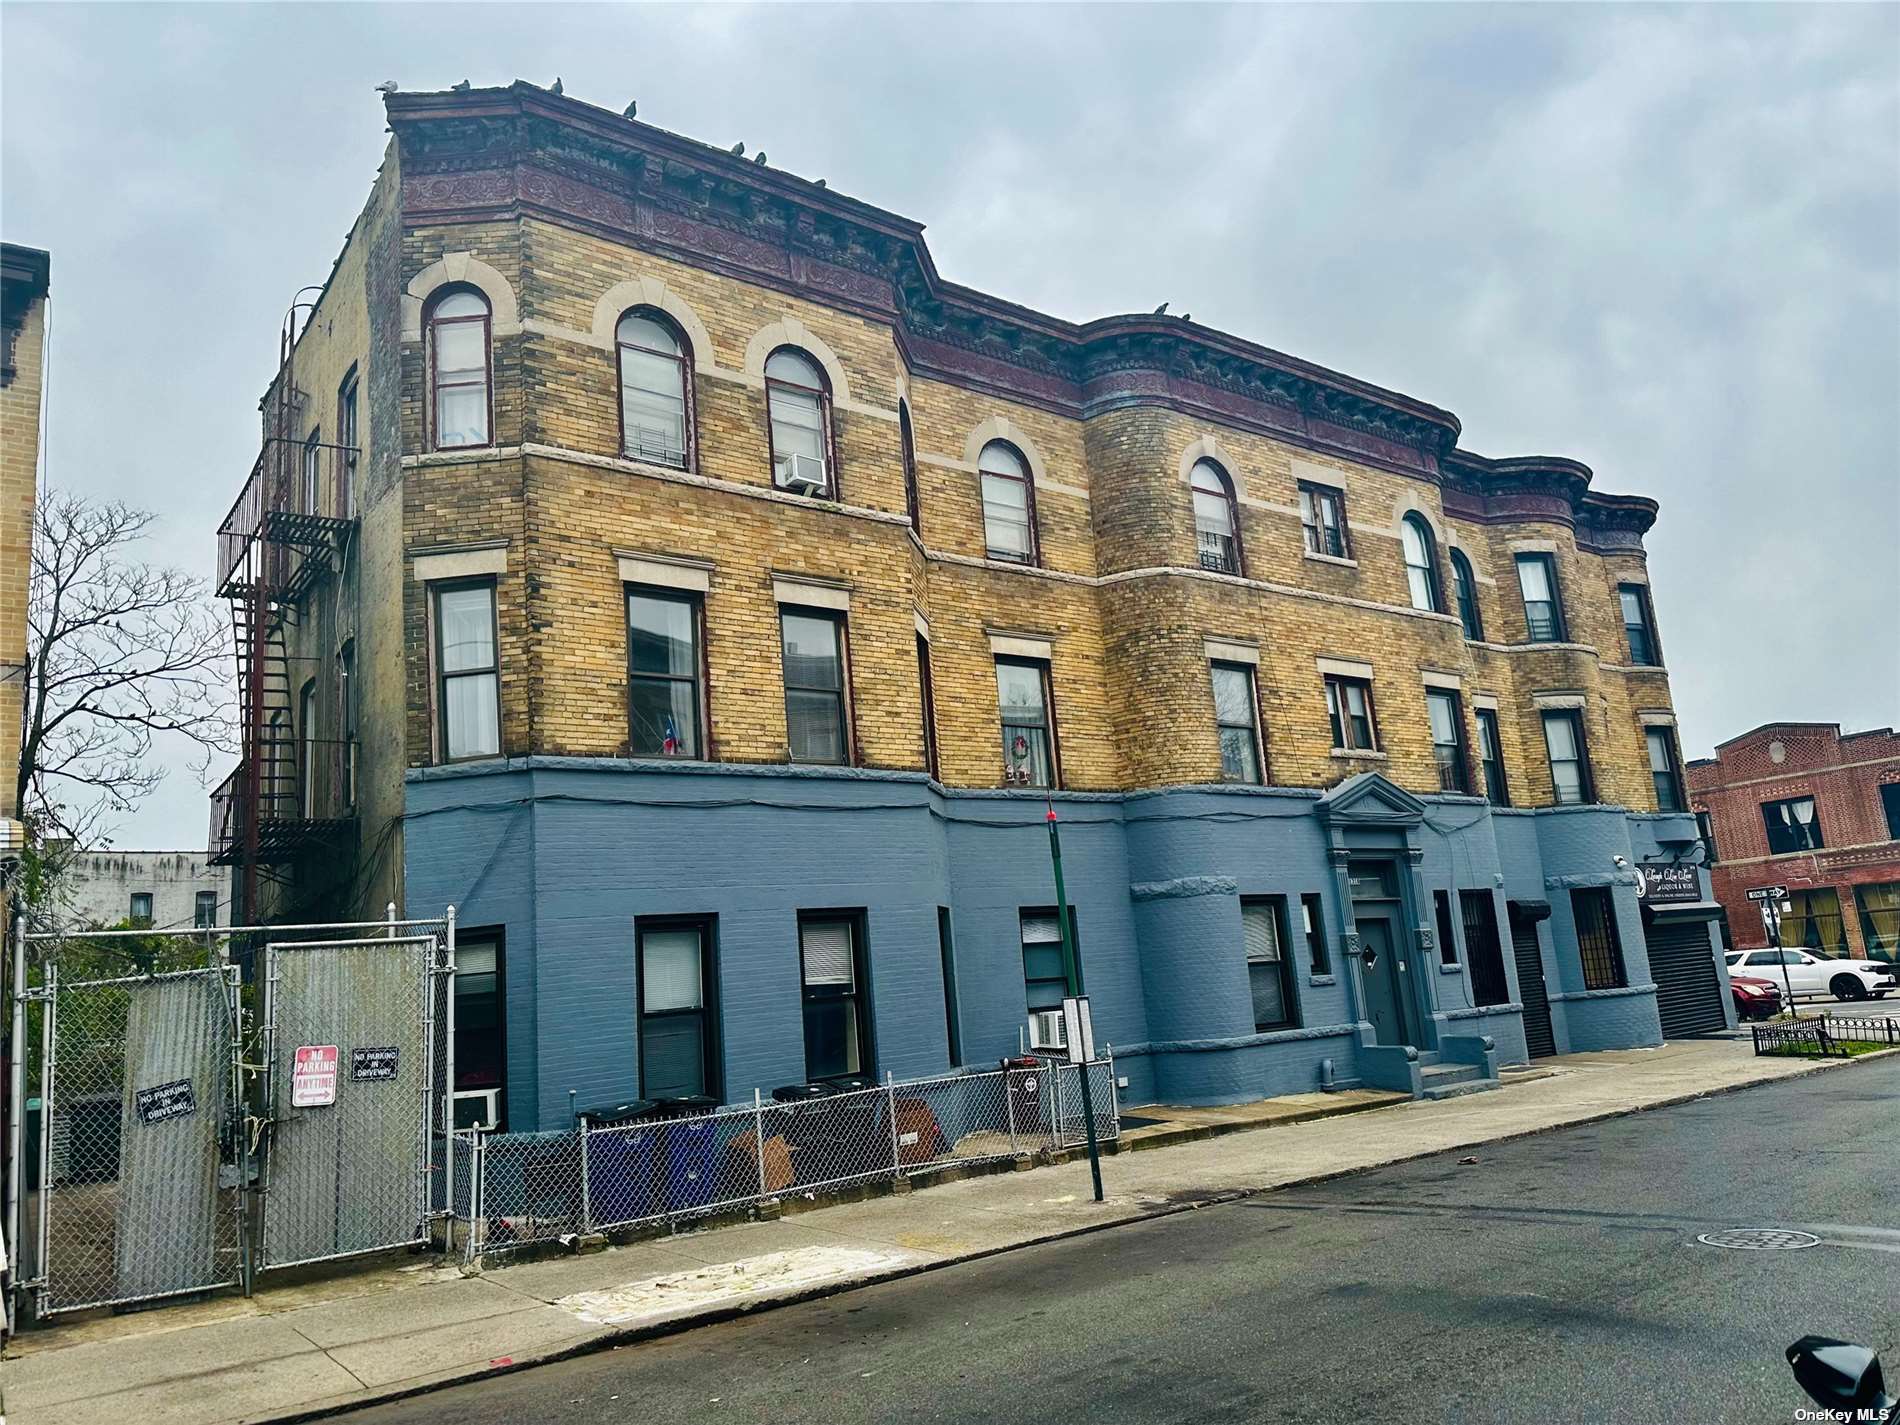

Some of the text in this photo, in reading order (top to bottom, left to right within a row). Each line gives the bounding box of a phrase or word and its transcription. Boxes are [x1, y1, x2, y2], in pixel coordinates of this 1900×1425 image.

[311, 1050, 323, 1060] NO
[367, 1052, 396, 1060] PARKING
[297, 1061, 335, 1073] PARKING
[357, 1068, 391, 1077] DRIVEWAY
[296, 1076, 333, 1089] ANYTIME
[140, 1084, 189, 1104] NO PARKING
[162, 1098, 171, 1107] IN
[148, 1101, 187, 1119] DRIVEWAY
